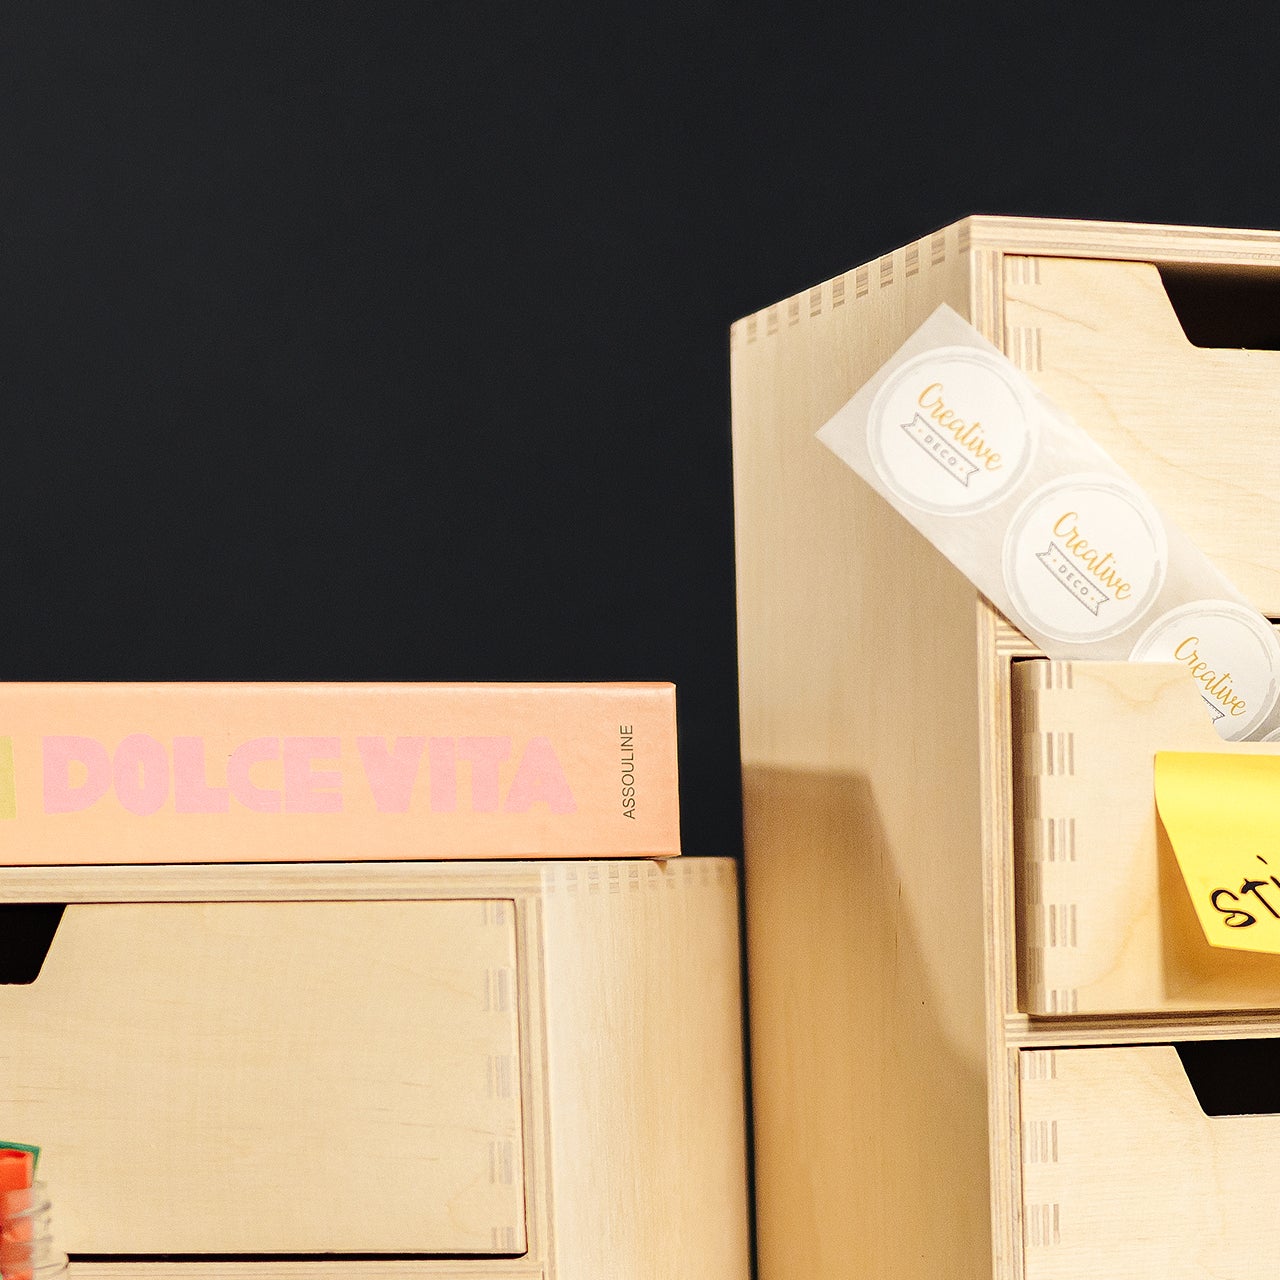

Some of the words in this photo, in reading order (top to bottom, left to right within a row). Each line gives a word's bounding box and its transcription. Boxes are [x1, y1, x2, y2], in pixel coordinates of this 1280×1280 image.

[917, 382, 1003, 472] Creative
[923, 434, 957, 467] DECO
[1052, 511, 1132, 601] Creative
[1057, 564, 1089, 596] DECO
[1173, 636, 1246, 717] Creative
[42, 733, 343, 816] DOLCE
[355, 735, 578, 814] VITA
[619, 723, 636, 820] ASSOULINE
